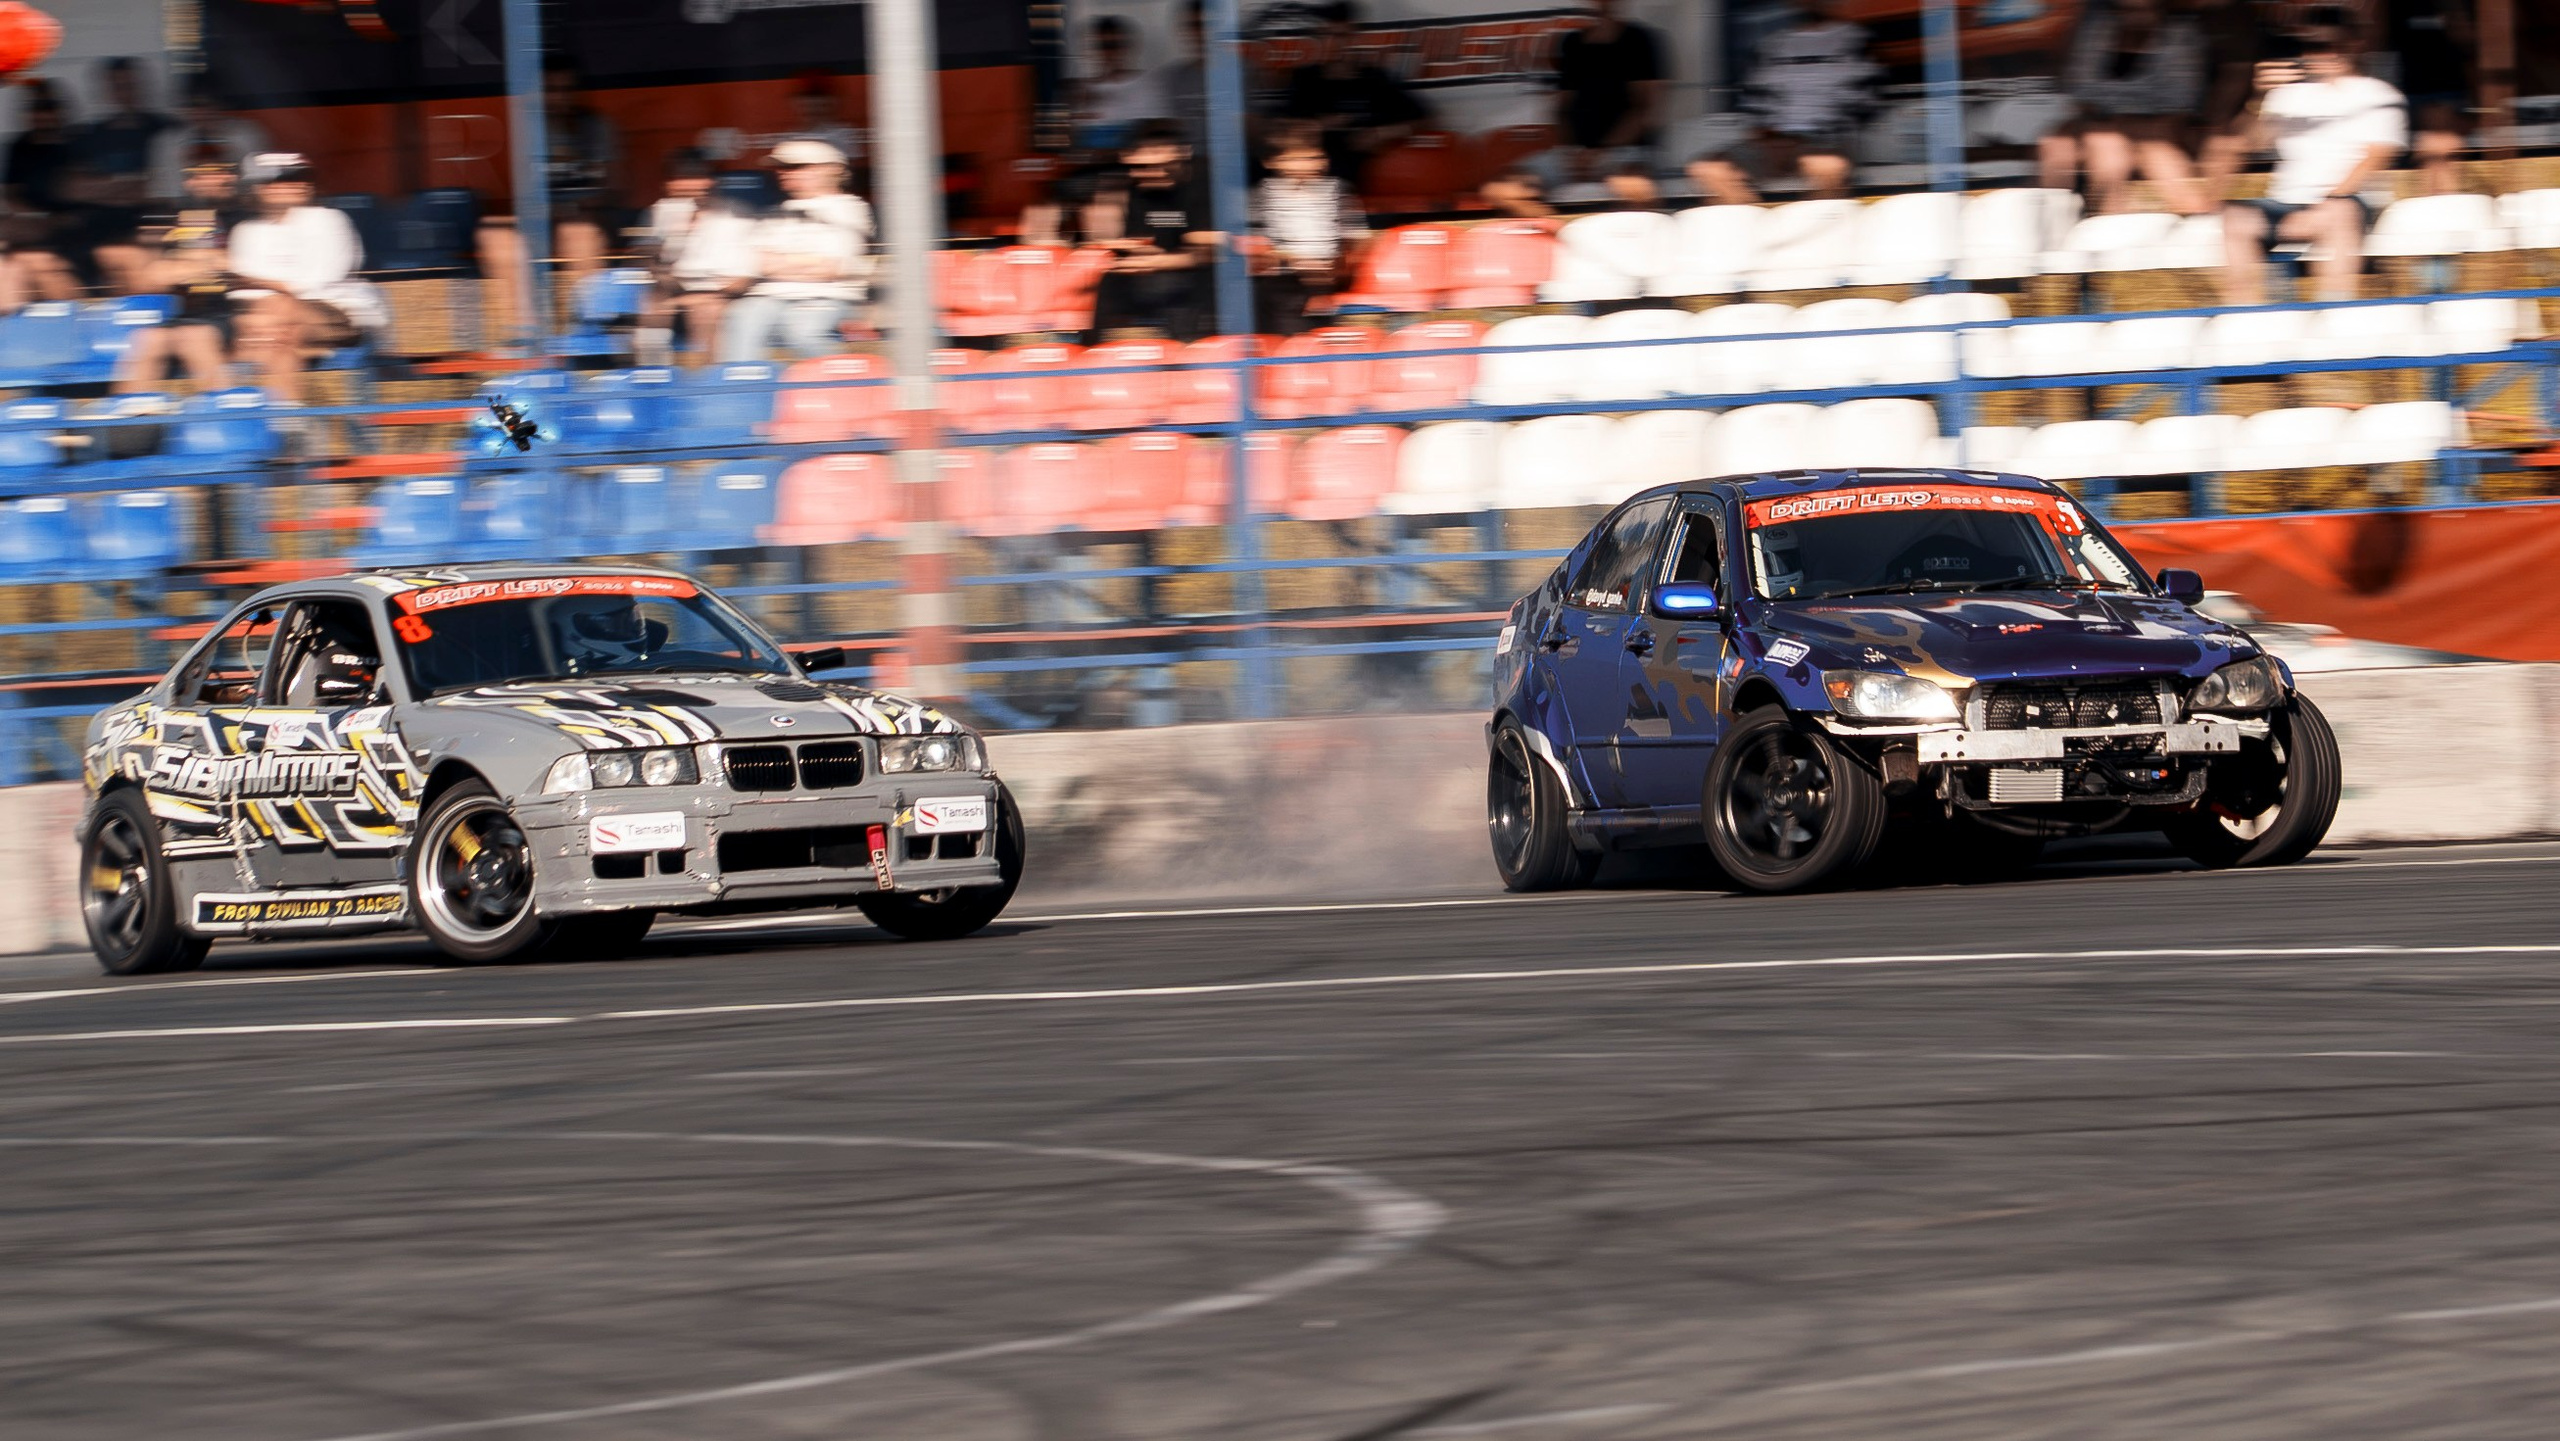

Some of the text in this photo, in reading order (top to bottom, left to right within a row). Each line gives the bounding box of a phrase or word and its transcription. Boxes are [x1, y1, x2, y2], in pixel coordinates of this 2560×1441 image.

[1770, 495, 1857, 519] DRIFT
[1860, 491, 1932, 508] LETO
[1924, 557, 1969, 570] sparco
[415, 583, 500, 609] DRIFT
[504, 578, 574, 595] LETO
[392, 614, 433, 644] 8
[941, 805, 984, 817] Tamashi
[626, 822, 682, 836] Tamashi
[213, 904, 261, 921] FROM
[265, 901, 331, 919] CIVILIAN
[334, 900, 352, 916] TO
